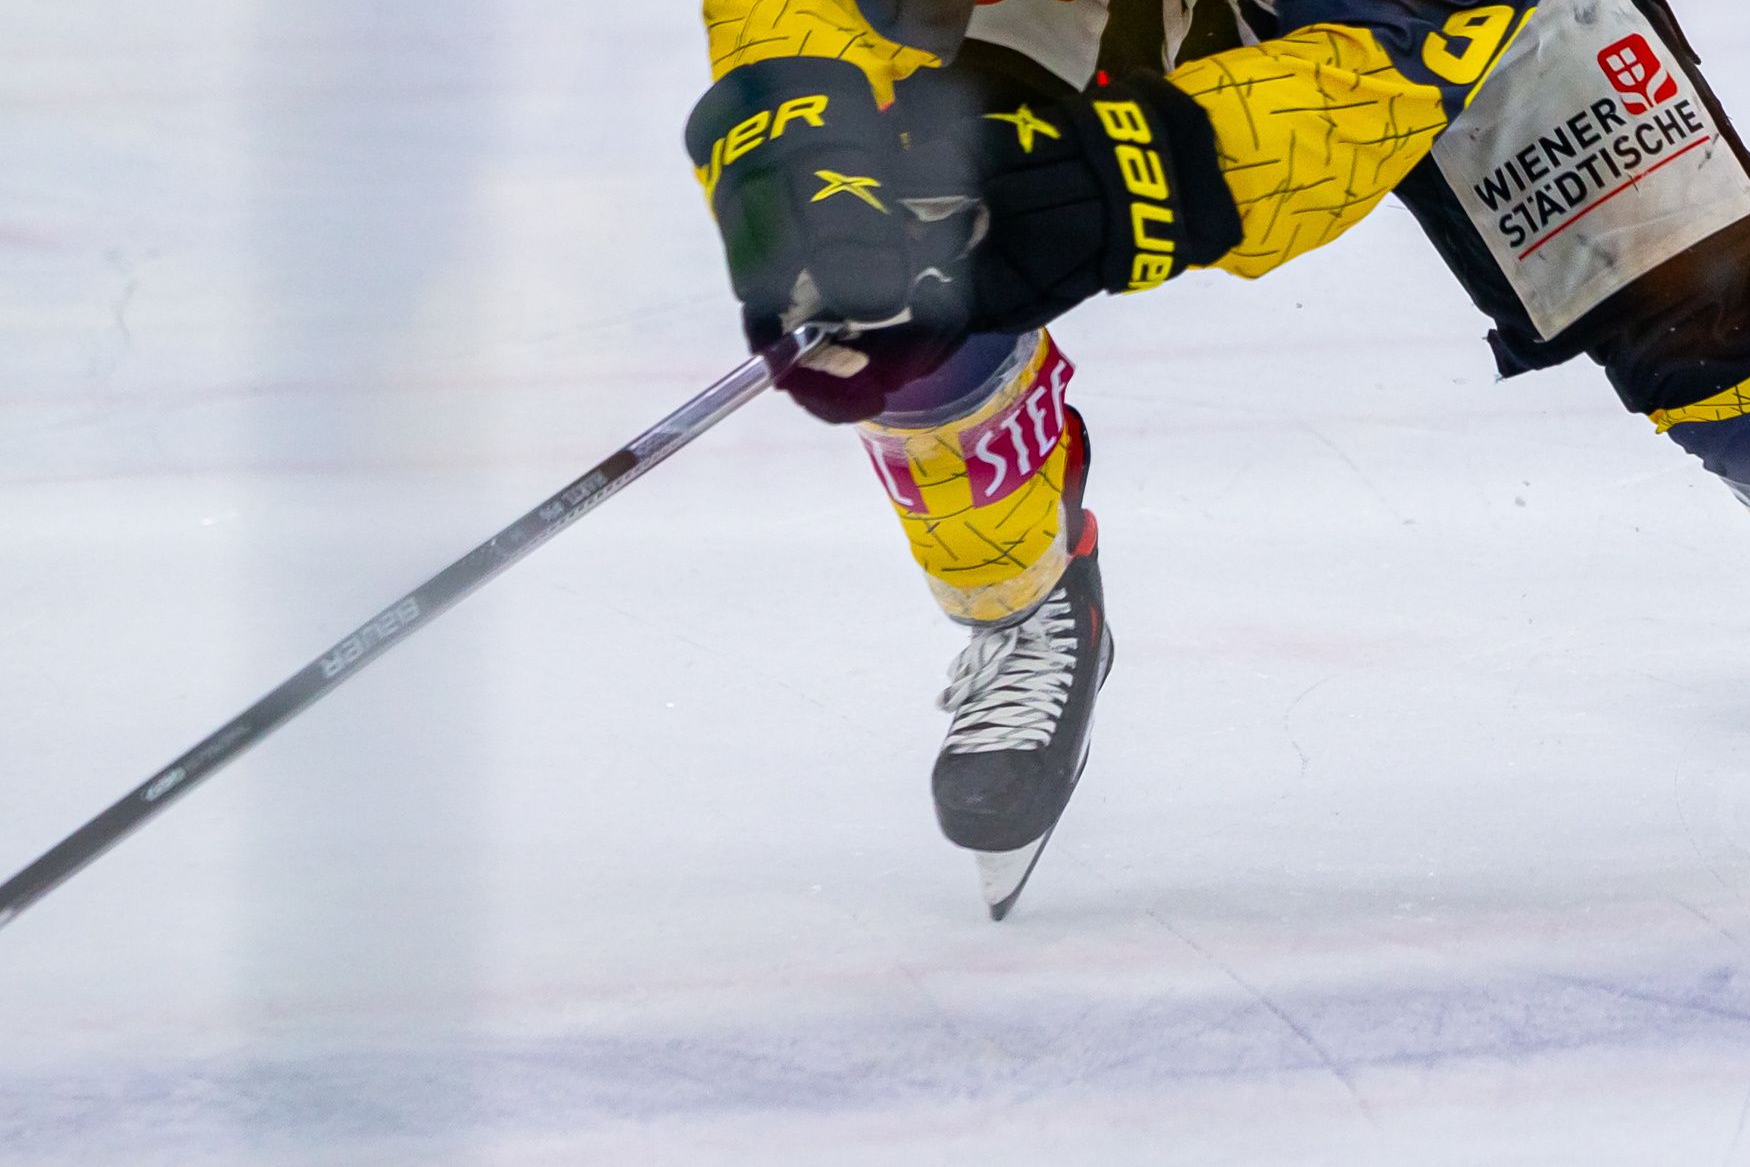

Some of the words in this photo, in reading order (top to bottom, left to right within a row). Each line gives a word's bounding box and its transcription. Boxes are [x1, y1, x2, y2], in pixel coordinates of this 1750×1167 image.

[1421, 4, 1537, 109] 9
[1473, 97, 1627, 213] WIENER
[1499, 99, 1705, 249] STÄDTISCHE
